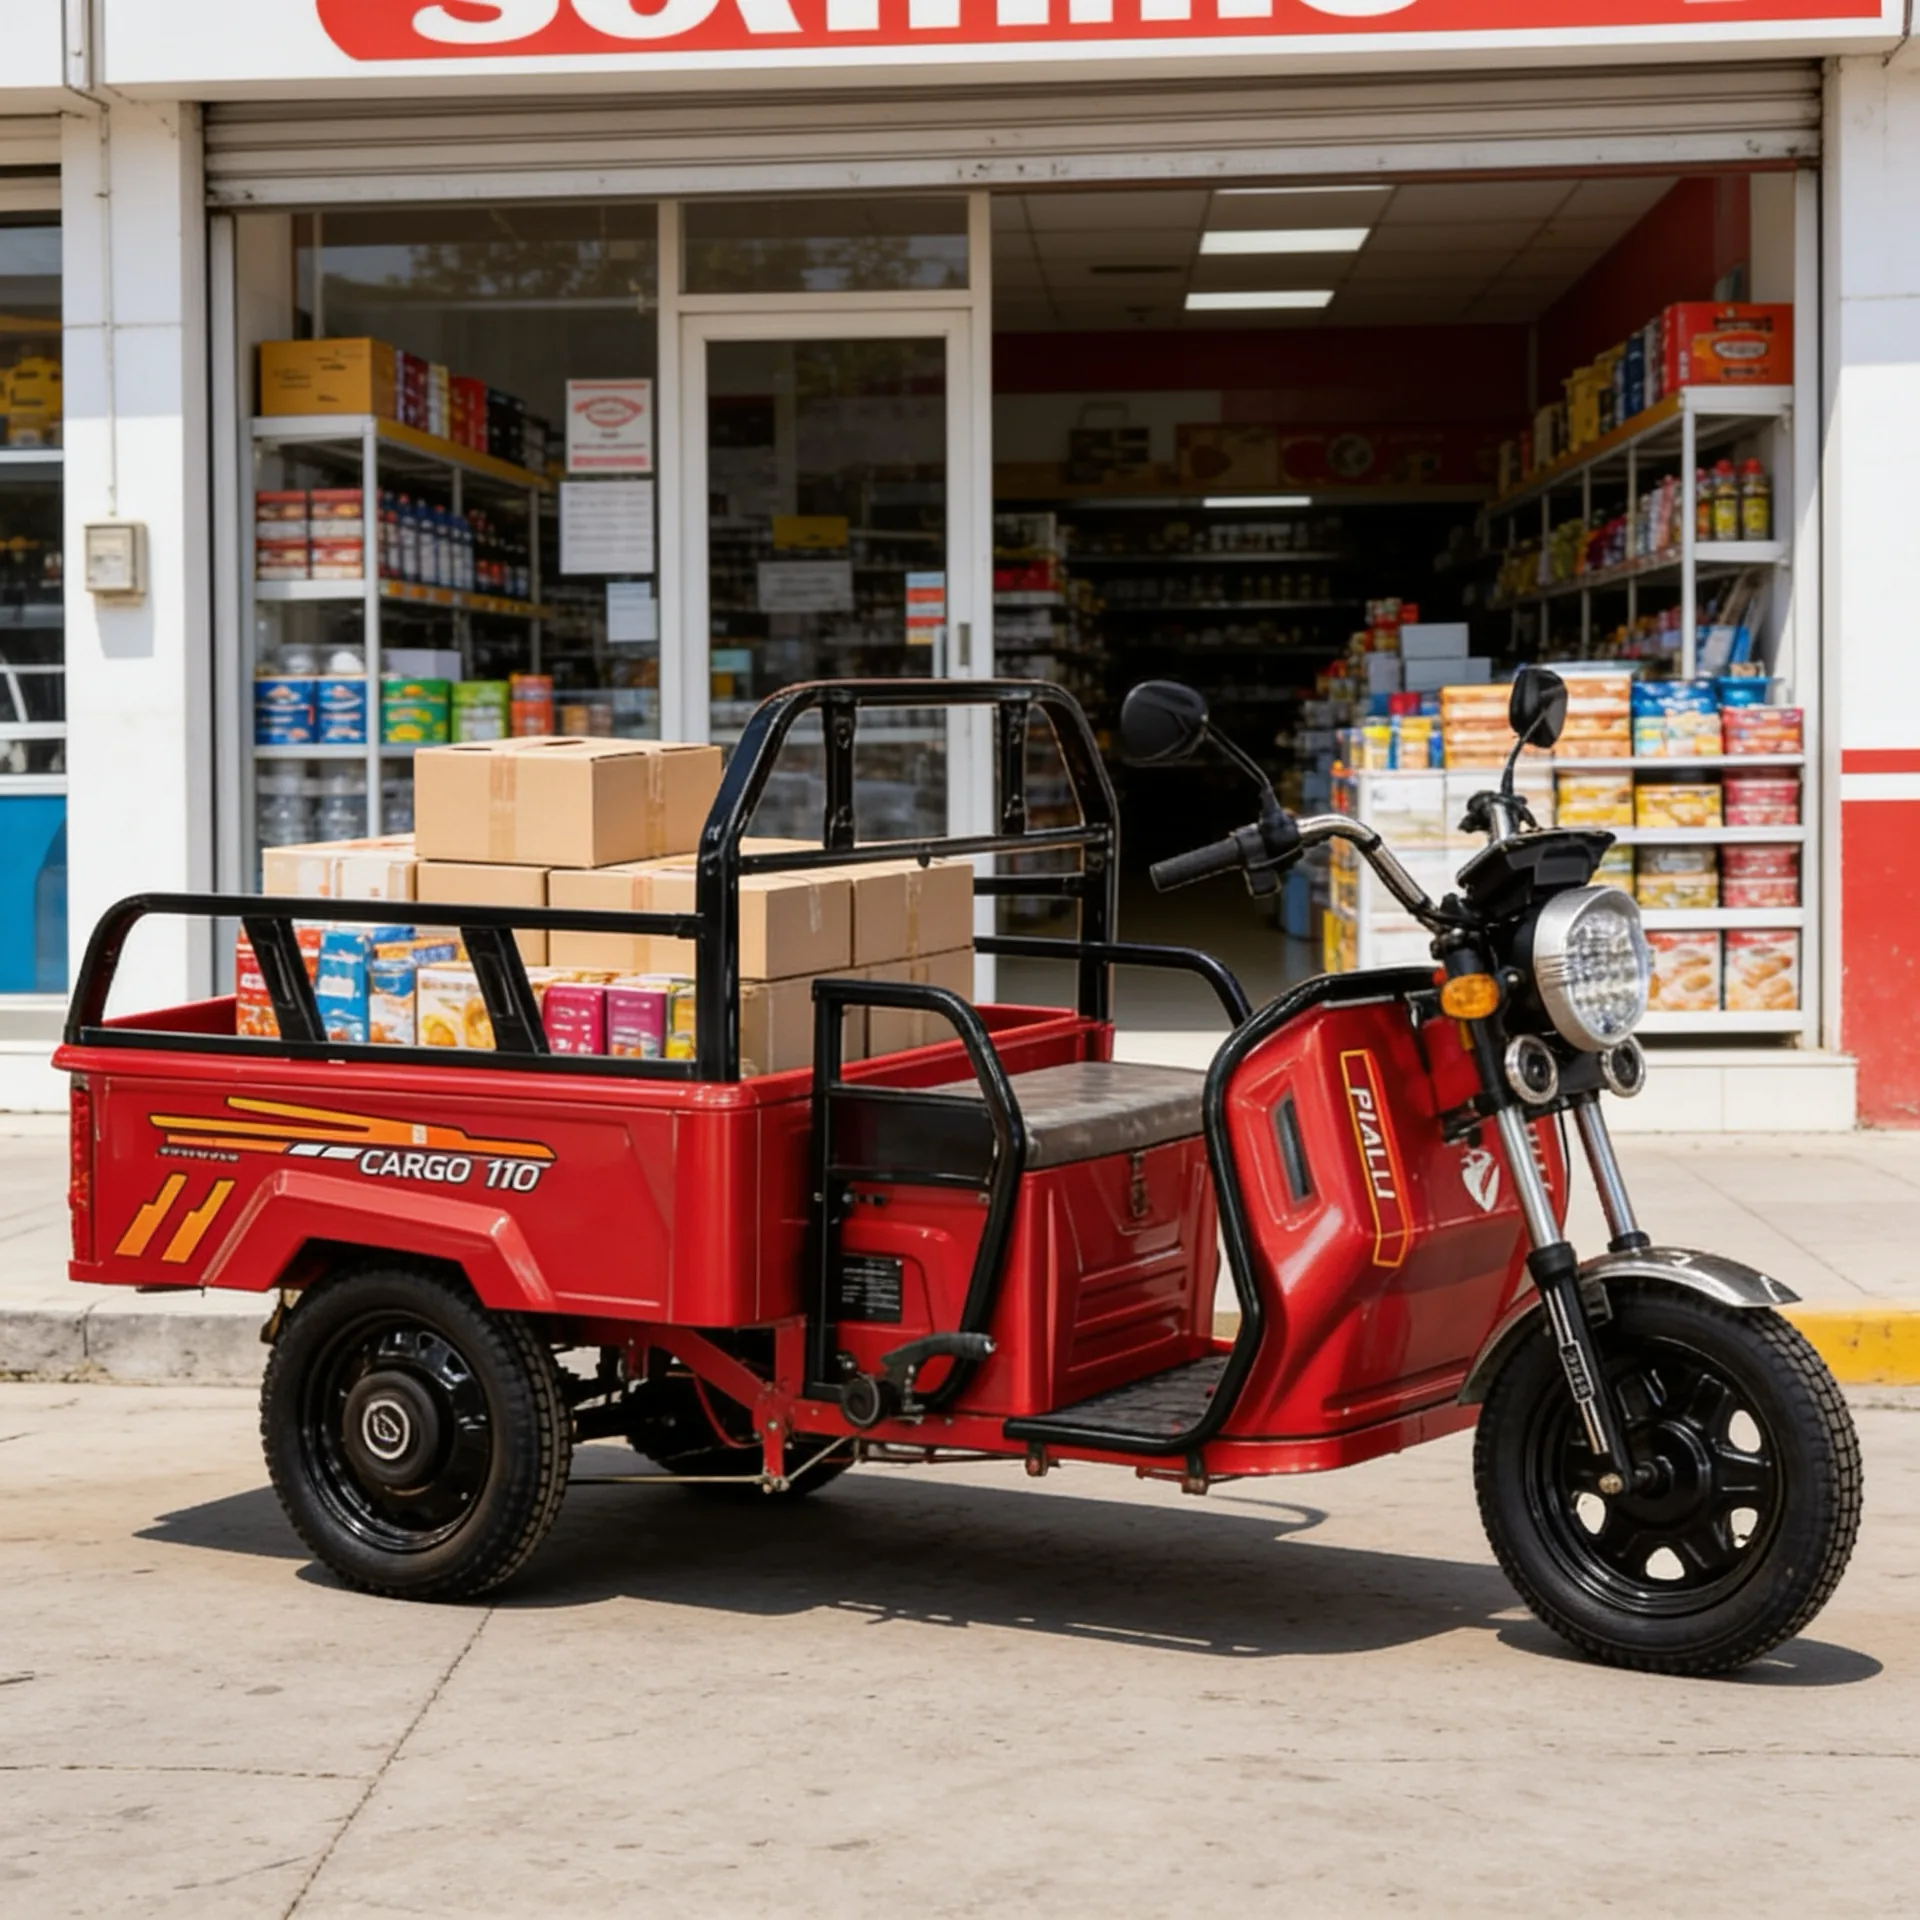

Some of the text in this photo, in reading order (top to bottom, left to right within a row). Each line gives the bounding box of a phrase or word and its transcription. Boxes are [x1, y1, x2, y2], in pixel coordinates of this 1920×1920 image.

[359, 1149, 542, 1192] CARGO 110
[1350, 1087, 1396, 1199] PIALLI
